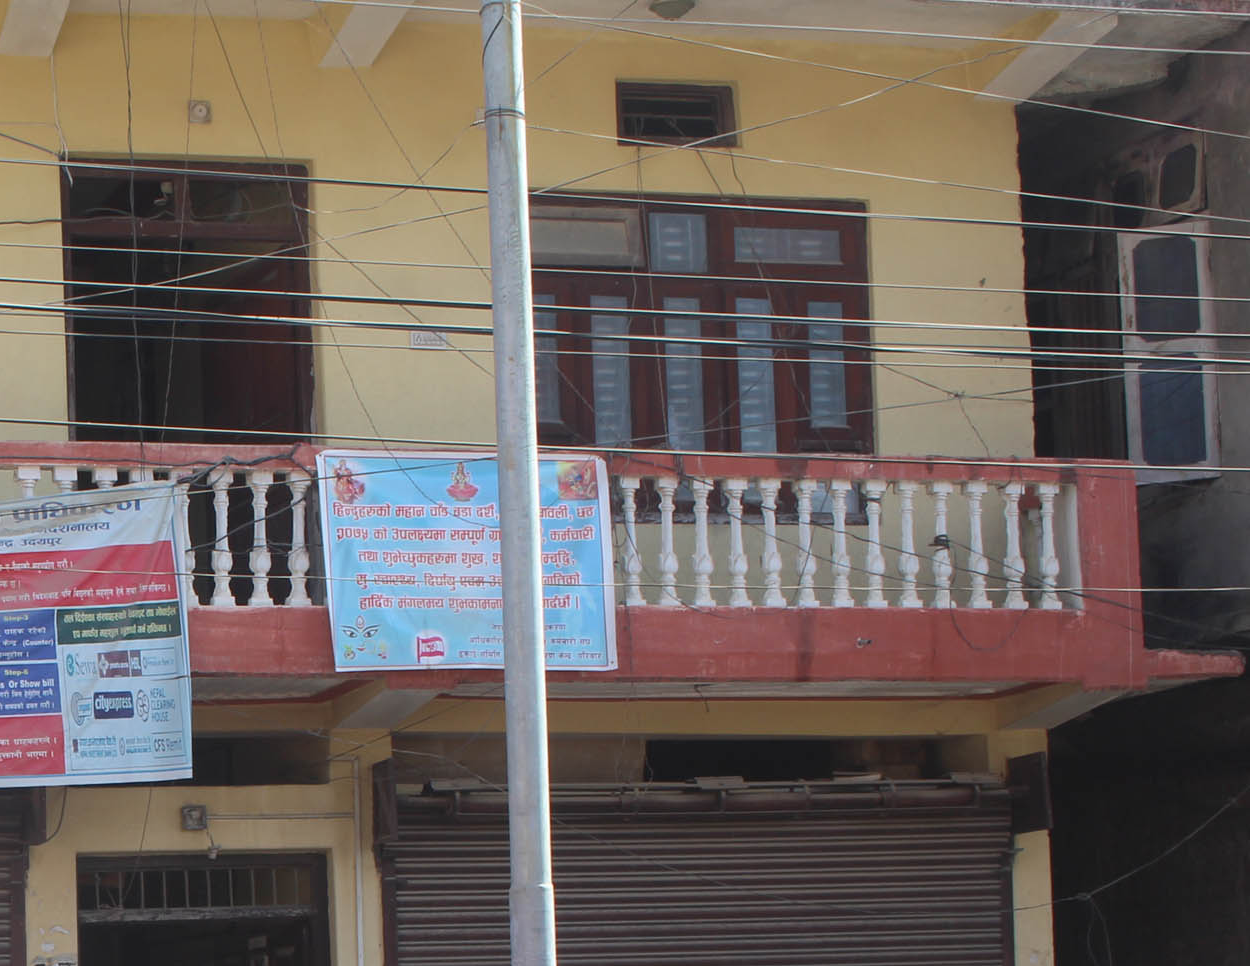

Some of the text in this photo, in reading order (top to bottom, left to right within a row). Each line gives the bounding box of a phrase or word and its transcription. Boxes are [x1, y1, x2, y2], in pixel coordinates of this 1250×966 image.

[332, 502, 391, 521] हिन्दुहरुको
[395, 504, 425, 519] महान
[20, 536, 62, 548] उदयपुर
[373, 526, 388, 540] को
[450, 526, 485, 545] सम्पूर्ण
[549, 526, 595, 542] कर्मचारी
[358, 550, 378, 563] तथा
[8, 680, 18, 689] Or
[19, 679, 40, 689] Show
[42, 678, 55, 688] bill
